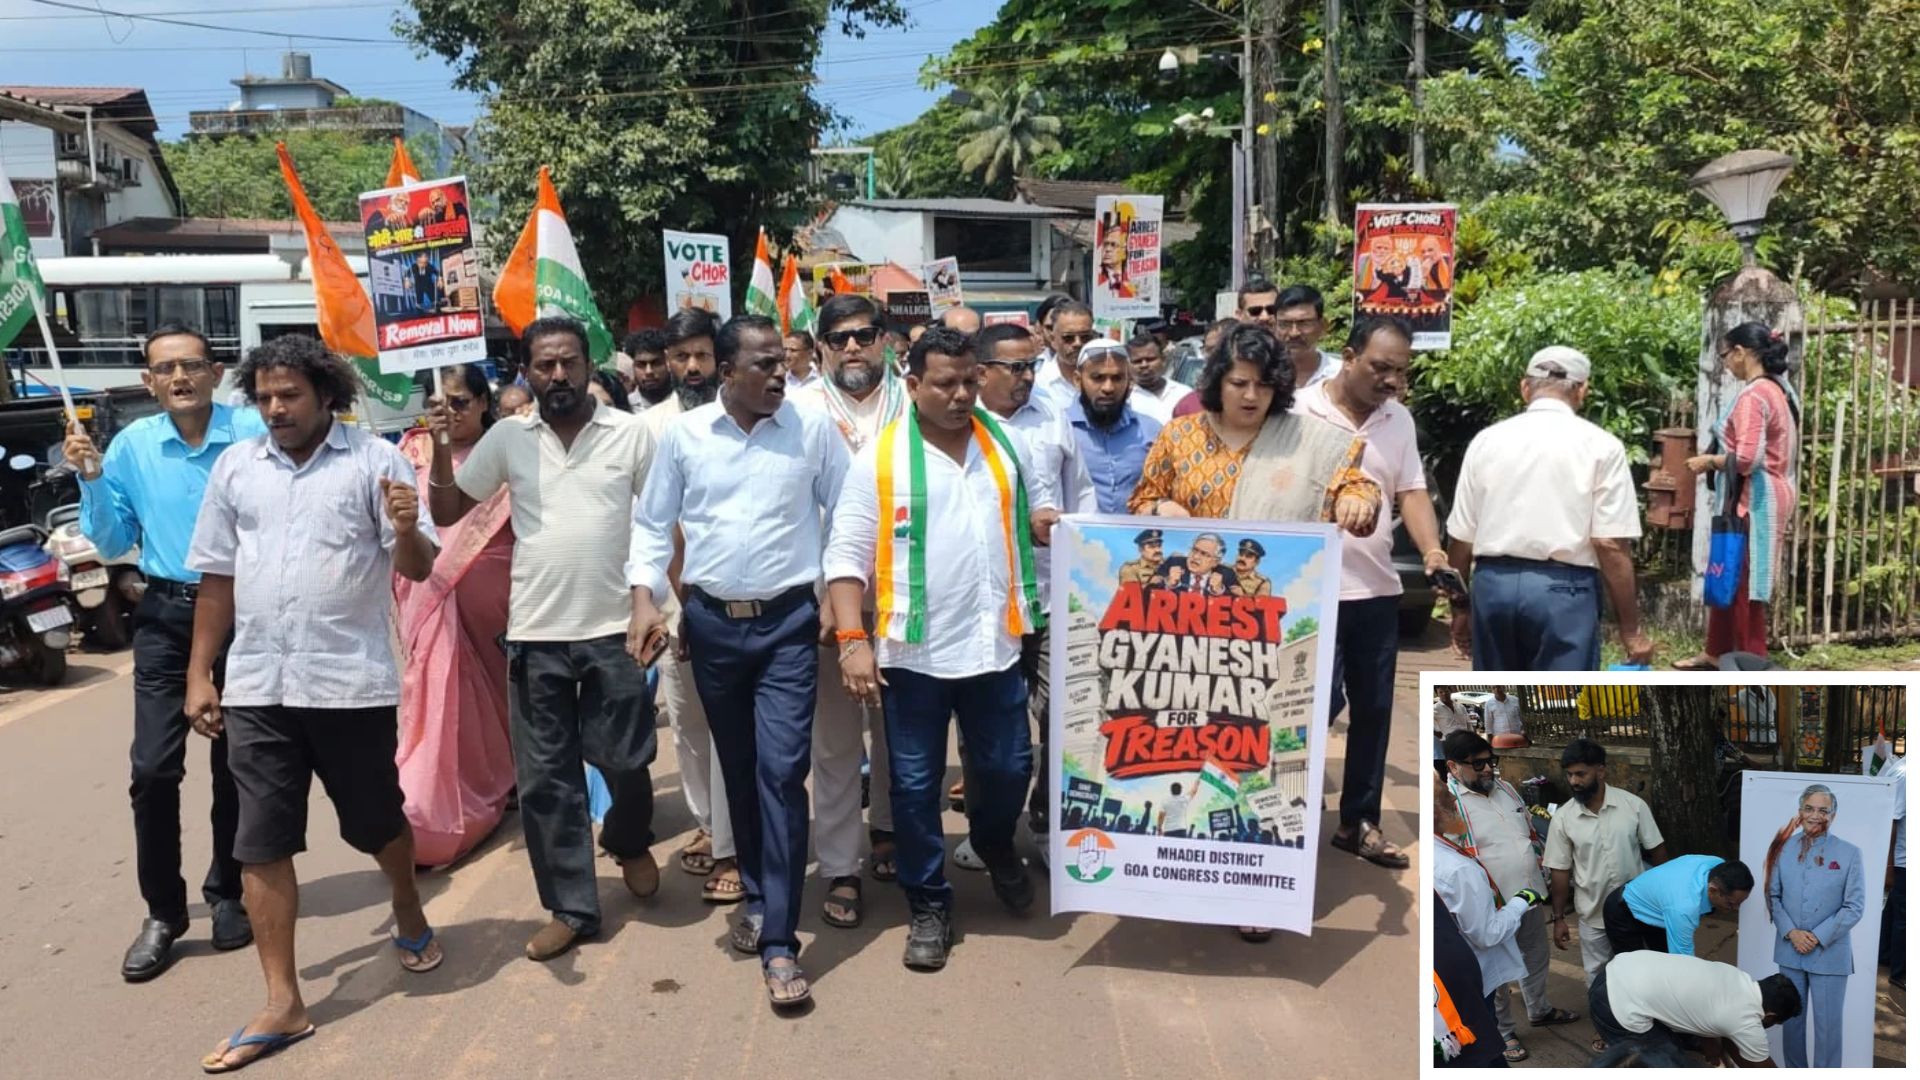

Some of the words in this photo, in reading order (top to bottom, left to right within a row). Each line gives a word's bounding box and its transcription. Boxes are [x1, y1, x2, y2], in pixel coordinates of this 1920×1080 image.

[1130, 220, 1159, 233] ARREST
[667, 241, 724, 263] VOTE
[691, 261, 727, 281] CHOR
[384, 318, 445, 347] Removal
[448, 315, 478, 335] Now
[1099, 581, 1287, 644] ARREST
[1100, 629, 1279, 680] GYANESH
[1106, 669, 1270, 722] KUMAR
[1167, 712, 1198, 725] FOR
[1100, 715, 1271, 767] TREASON
[1157, 846, 1205, 863] MHADEI
[1210, 851, 1264, 868] DISTRICT
[1124, 863, 1149, 877] GOA
[1153, 866, 1219, 884] CONGRESS
[1223, 871, 1296, 891] COMMITTEE
